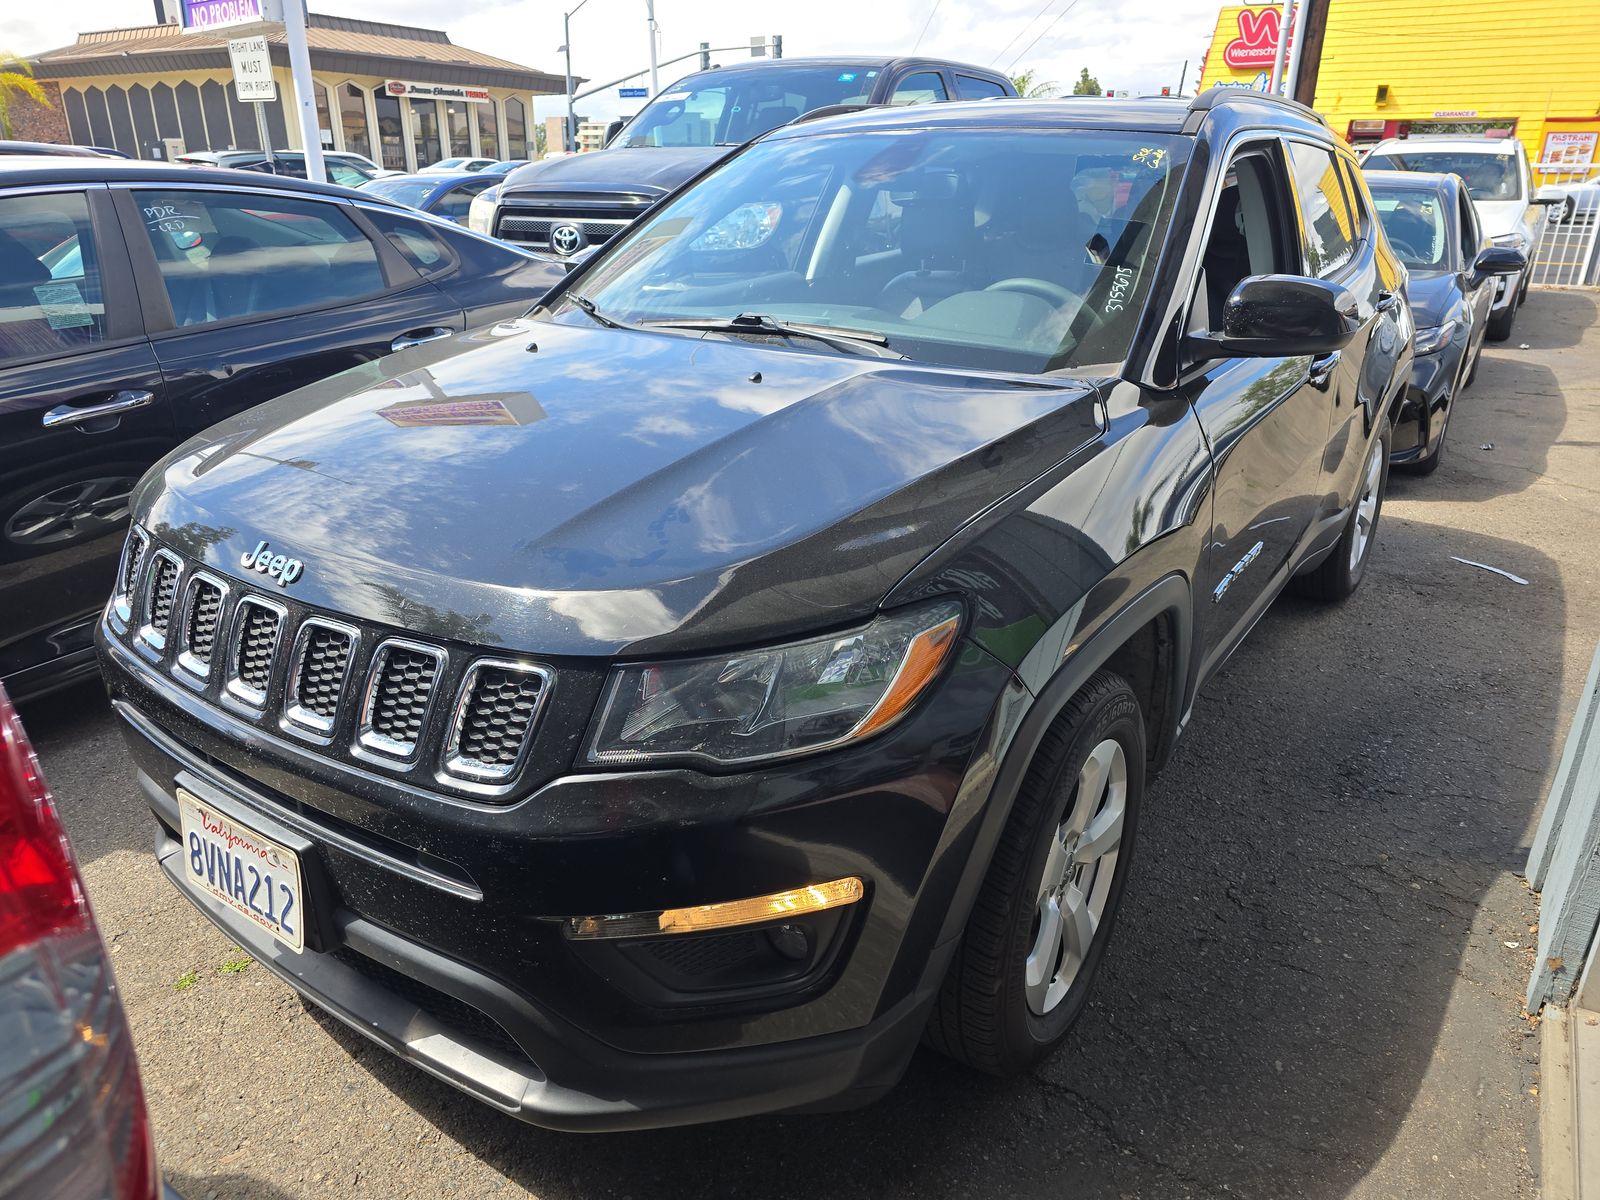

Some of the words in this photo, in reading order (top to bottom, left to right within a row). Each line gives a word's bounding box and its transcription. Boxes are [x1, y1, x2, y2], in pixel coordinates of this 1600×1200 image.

[192, 6, 208, 28] NO
[209, 0, 254, 24] PROBLEM
[231, 42, 248, 53] RIGHT
[249, 40, 265, 52] LANE
[240, 60, 262, 73] MUST
[238, 81, 254, 92] TURN
[255, 80, 272, 91] RIGHT
[143, 206, 181, 218] PDR
[240, 541, 304, 588] Jeep
[202, 812, 278, 868] California
[189, 831, 294, 935] 8VNA212
[212, 888, 274, 929] dmv.ca.gov
